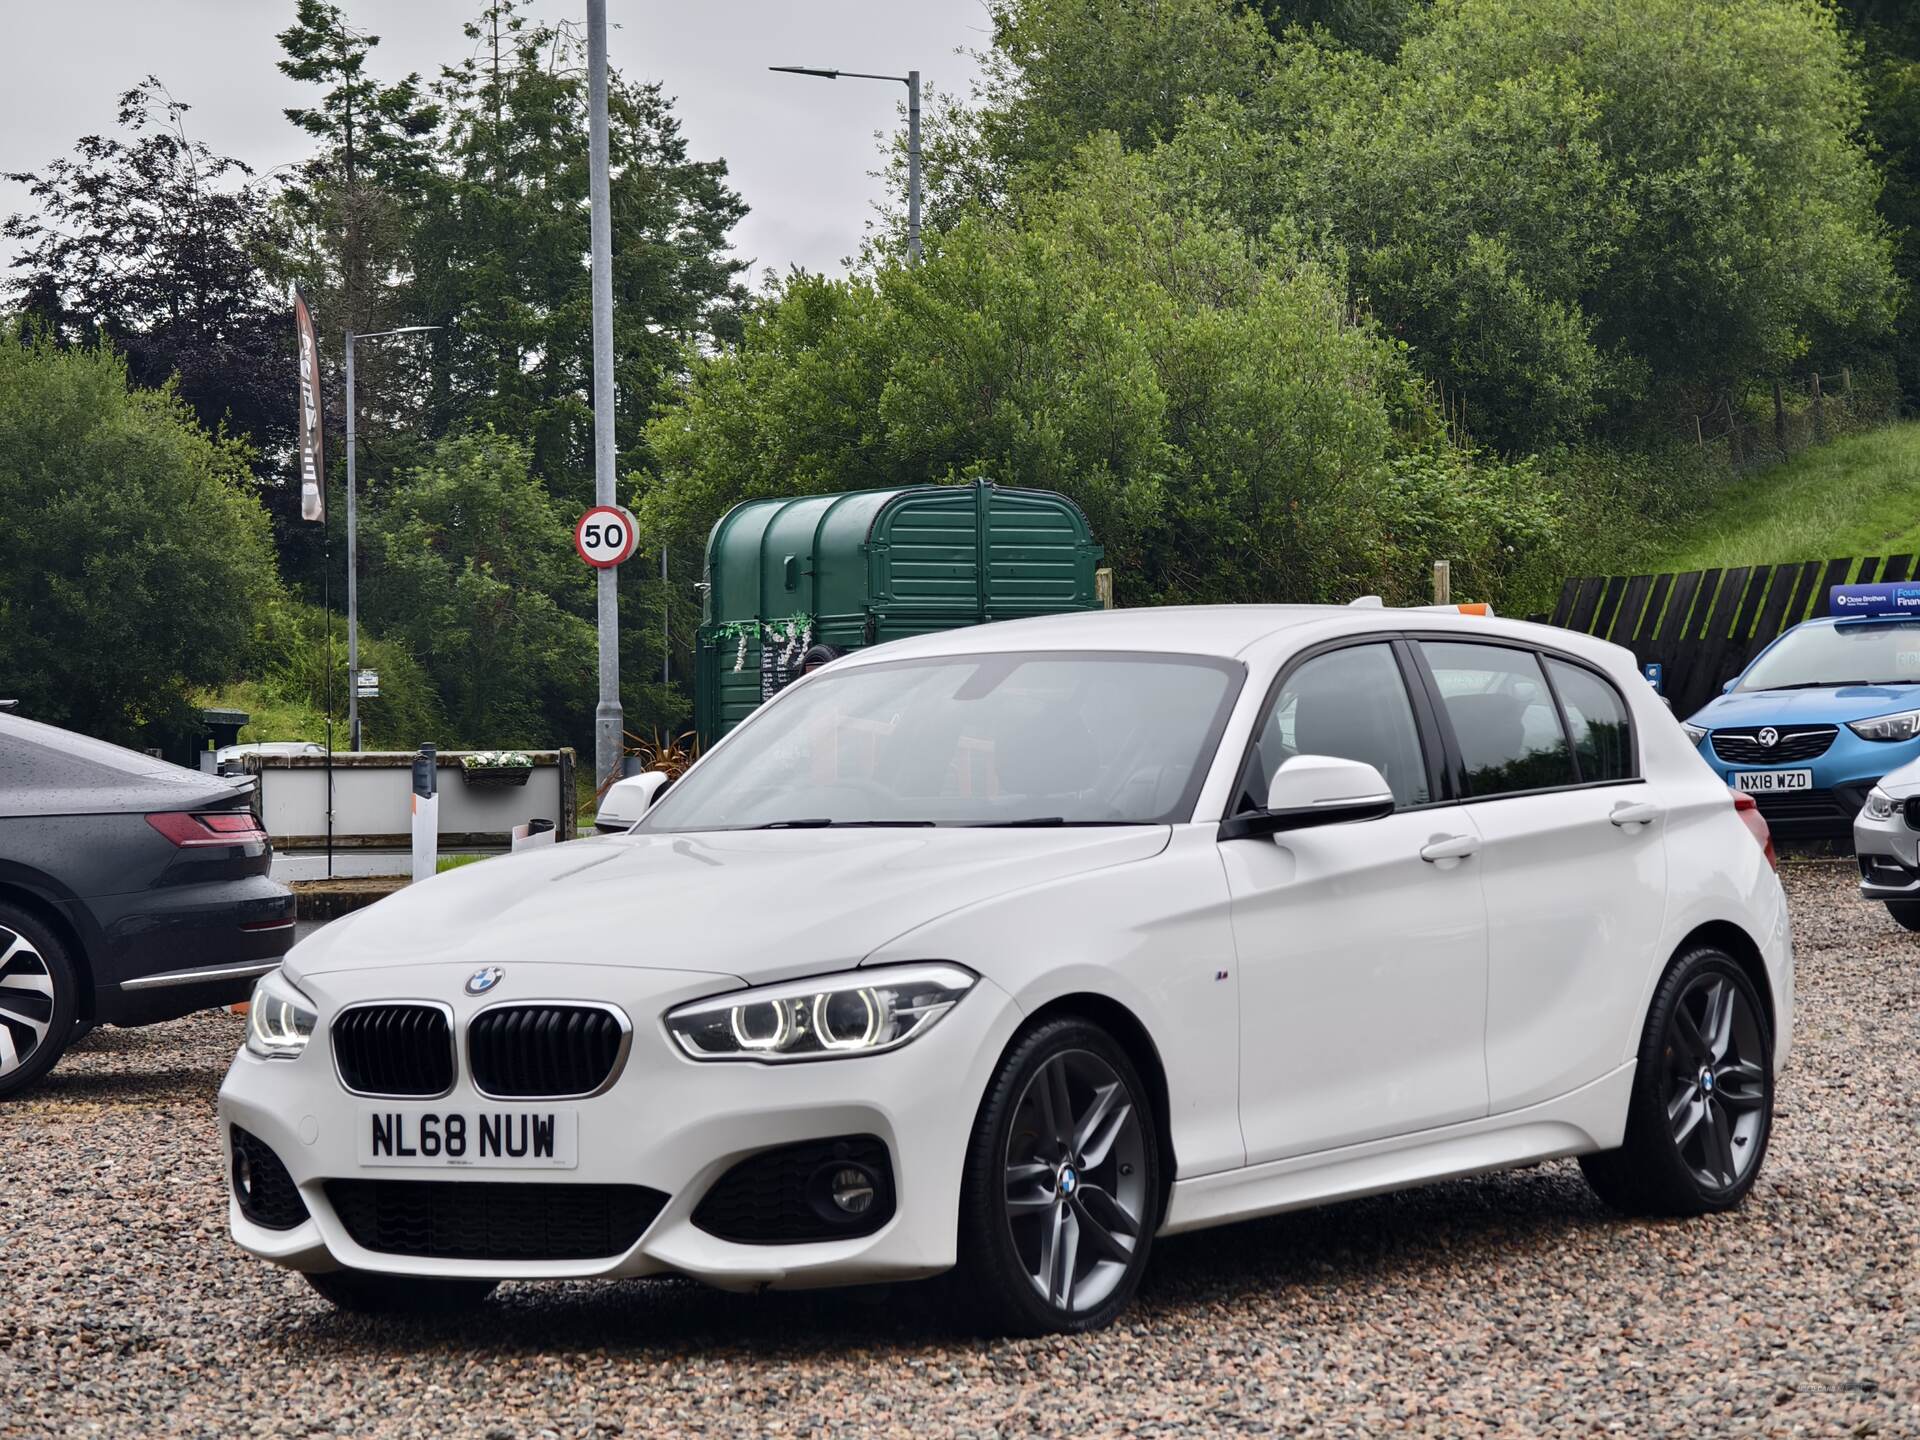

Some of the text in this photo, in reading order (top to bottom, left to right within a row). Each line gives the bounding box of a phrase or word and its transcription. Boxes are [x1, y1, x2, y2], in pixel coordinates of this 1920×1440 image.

[585, 524, 623, 549] 50
[1740, 773, 1806, 790] NX18 WZD
[372, 1113, 555, 1158] NL68 NUW
